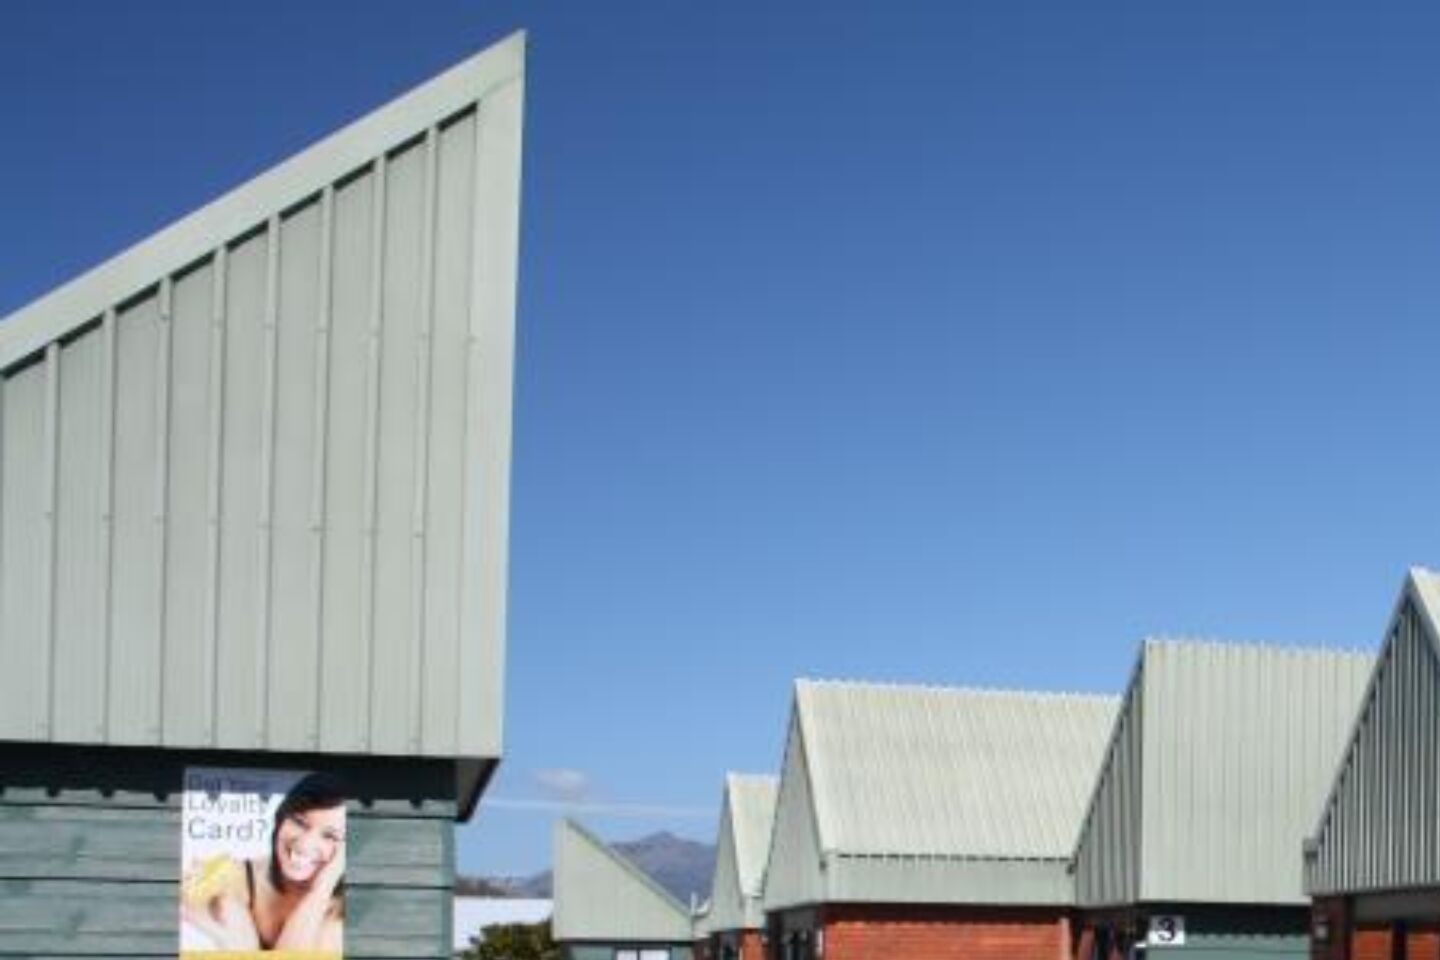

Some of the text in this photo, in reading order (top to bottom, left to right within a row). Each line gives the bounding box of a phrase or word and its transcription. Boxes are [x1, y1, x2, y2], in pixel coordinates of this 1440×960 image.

[188, 791, 268, 814] Loyalty
[188, 817, 268, 841] Card?
[1157, 917, 1176, 941] 3
